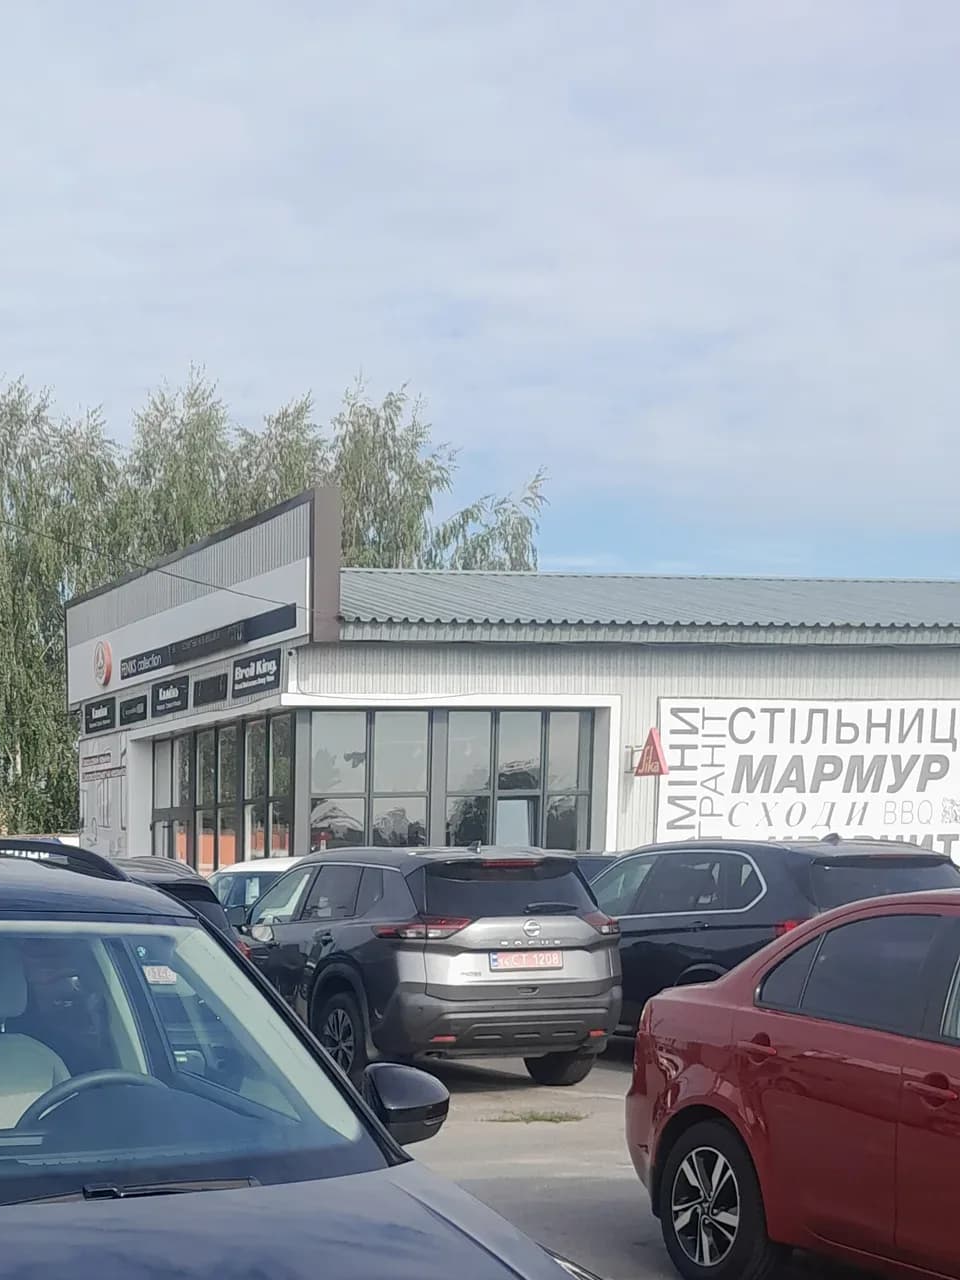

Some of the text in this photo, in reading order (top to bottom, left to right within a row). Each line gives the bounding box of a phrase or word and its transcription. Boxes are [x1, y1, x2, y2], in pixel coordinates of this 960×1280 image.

[234, 662, 256, 680] Broil
[730, 754, 950, 794] МАРМУР
[727, 800, 869, 831] СХОДИ
[883, 799, 933, 825] BBQ
